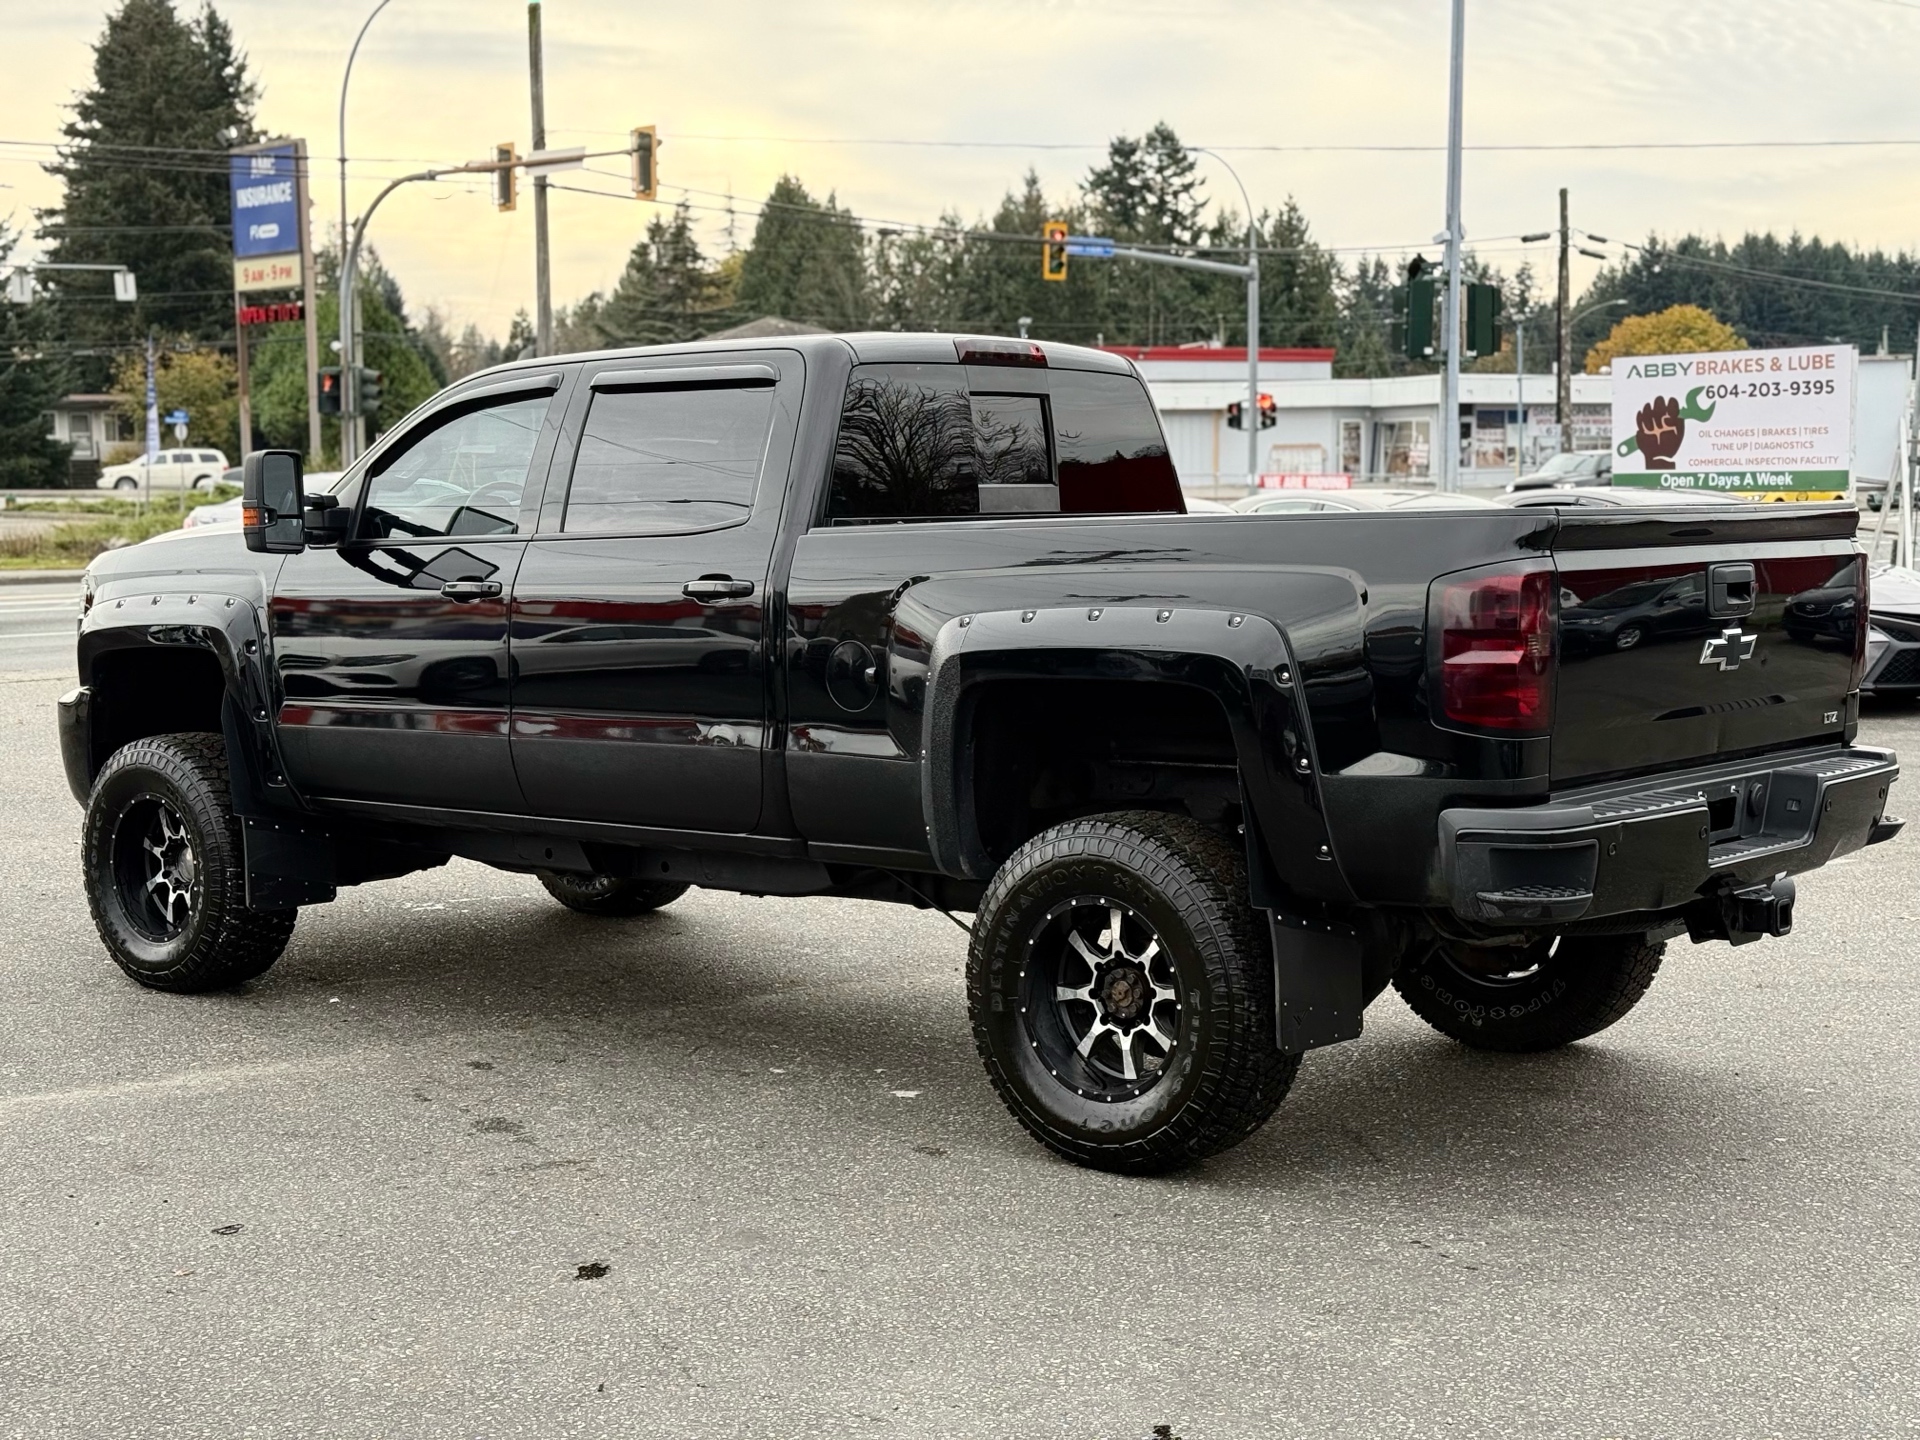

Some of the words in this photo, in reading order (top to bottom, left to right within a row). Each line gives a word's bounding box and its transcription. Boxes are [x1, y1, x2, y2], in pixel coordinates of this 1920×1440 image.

[236, 181, 292, 209] INSURANCE
[243, 266, 250, 284] 9
[251, 268, 265, 282] AM
[271, 263, 278, 281] 9
[279, 265, 293, 279] PM
[240, 306, 266, 325] OPEN
[1626, 361, 1694, 379] ABBY
[1695, 357, 1765, 376] BRAKES
[1769, 356, 1783, 372] &
[1787, 353, 1836, 371] LUBE
[1705, 379, 1836, 400] 604-203-9395
[1698, 429, 1712, 438] OIL
[1714, 428, 1755, 438] CHANGES
[1761, 427, 1797, 436] BRAKES
[1803, 426, 1829, 435] TIRES
[1711, 442, 1734, 451] TUNE
[1736, 442, 1749, 450] UP
[1754, 441, 1814, 450] DIAGNOSTICS
[1688, 458, 1743, 467] COMMERCIAL
[1745, 457, 1798, 466] INSPECTION
[1800, 456, 1840, 465] FACILITY
[1660, 473, 1694, 489] Open
[1697, 473, 1705, 486] 7
[1708, 472, 1740, 489] Days
[1743, 472, 1754, 486] A
[1756, 471, 1793, 486] Week
[1823, 711, 1838, 724] LTZ
[989, 864, 1086, 1013] DESTINATION
[1421, 974, 1566, 1020] Firestone
